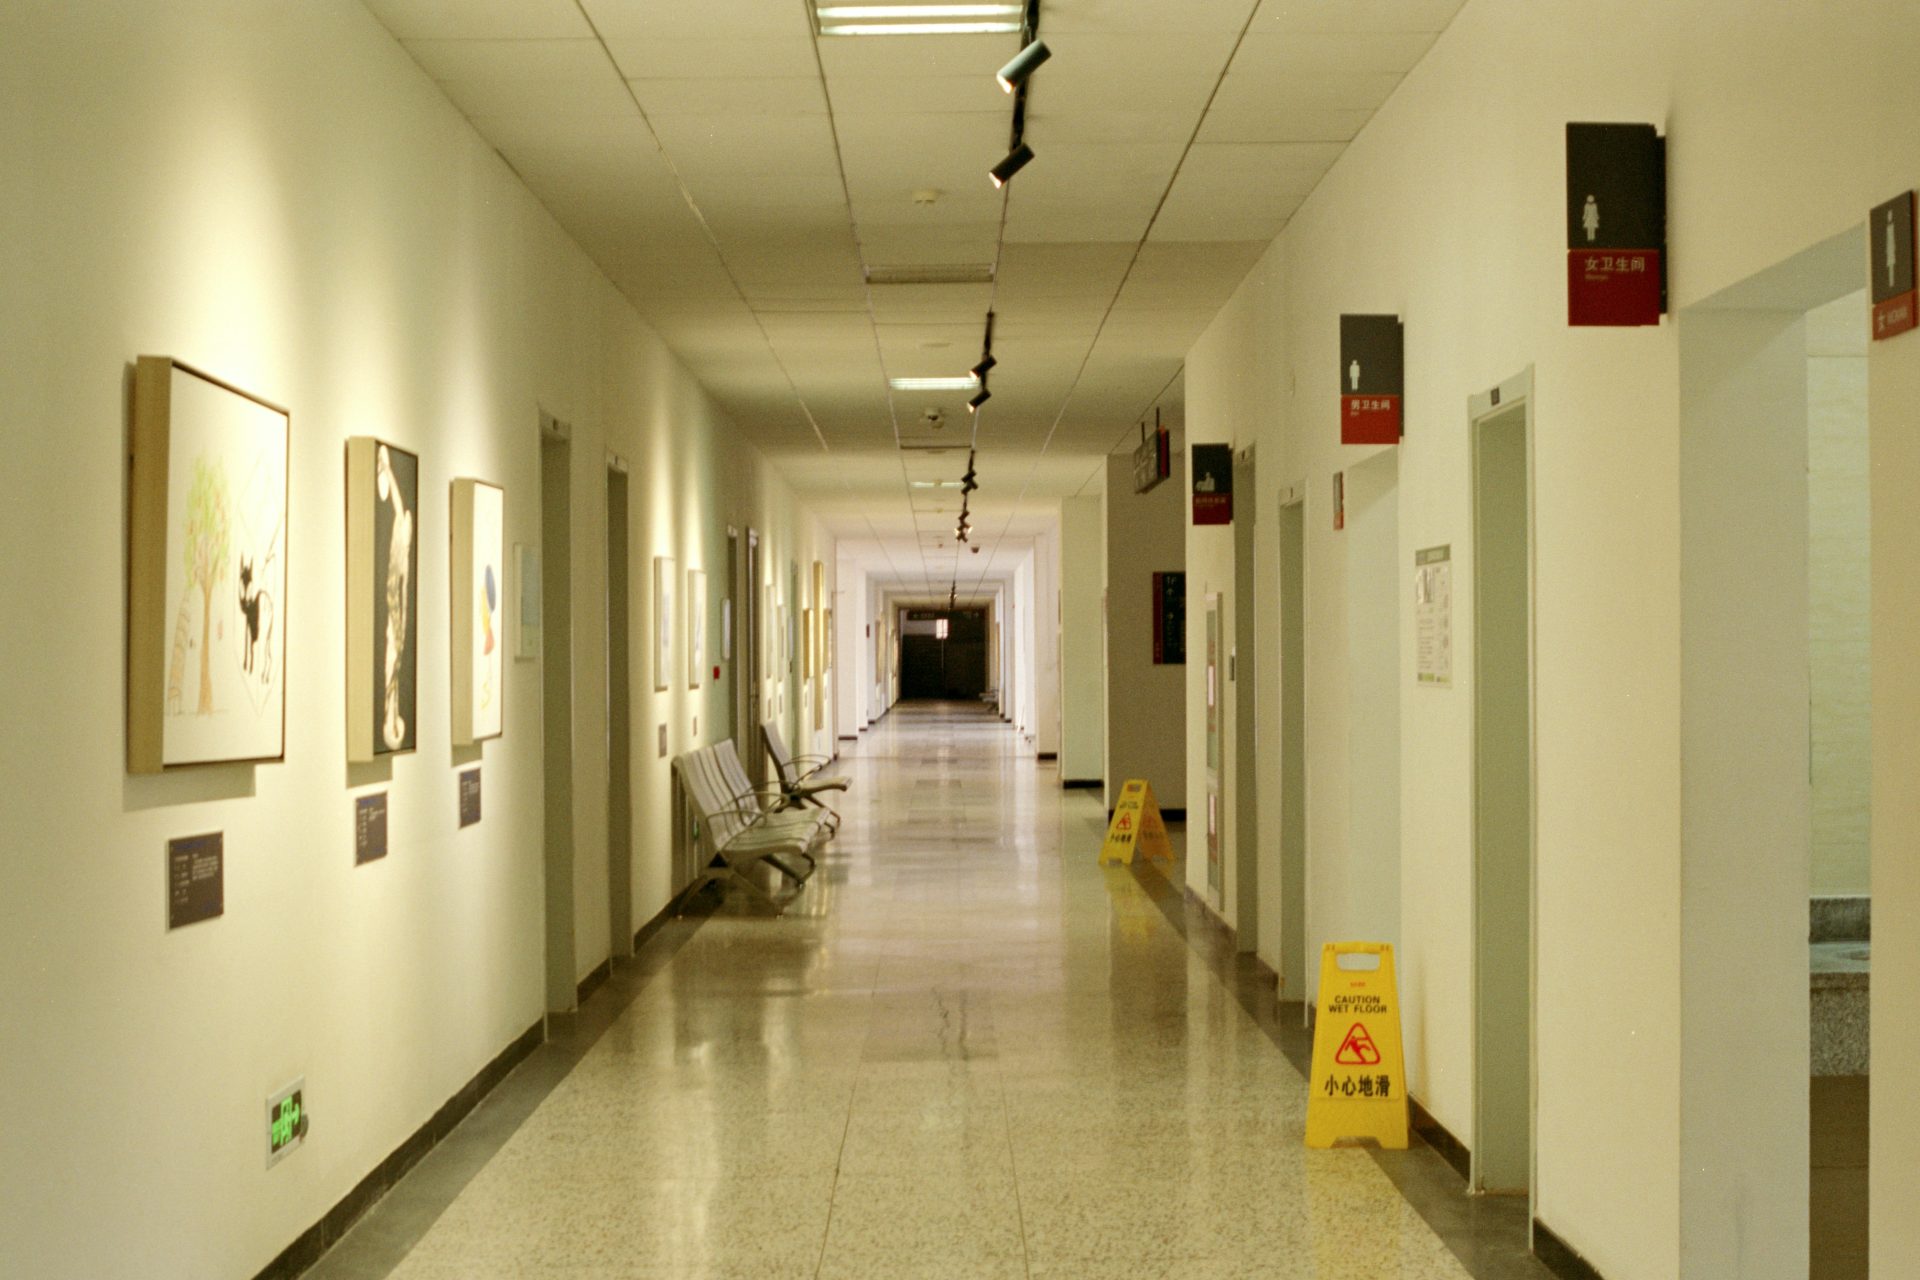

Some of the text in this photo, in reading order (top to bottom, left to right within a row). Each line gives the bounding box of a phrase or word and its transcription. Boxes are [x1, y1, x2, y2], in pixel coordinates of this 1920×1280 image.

[1584, 255, 1646, 273] 女卫生间
[1351, 399, 1391, 411] 男卫生间
[1334, 995, 1380, 1004] CAUTION
[1328, 1004, 1387, 1014] WET FLOOR
[1324, 1074, 1390, 1097] 小心地滑
